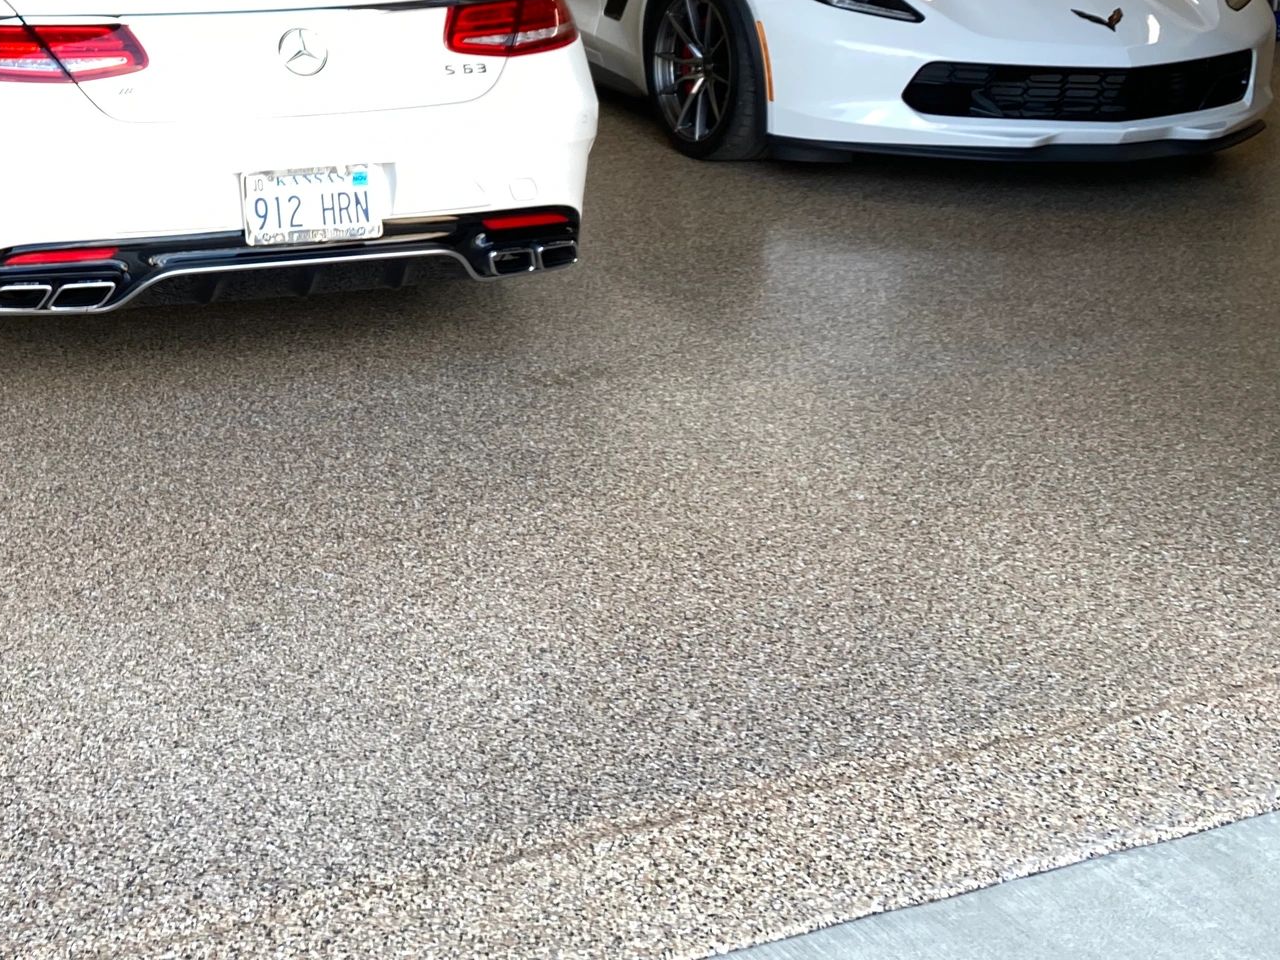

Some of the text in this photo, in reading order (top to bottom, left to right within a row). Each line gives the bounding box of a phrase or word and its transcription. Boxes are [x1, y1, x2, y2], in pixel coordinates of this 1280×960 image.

[445, 63, 487, 75] S 63
[254, 191, 370, 230] 912 HRN
